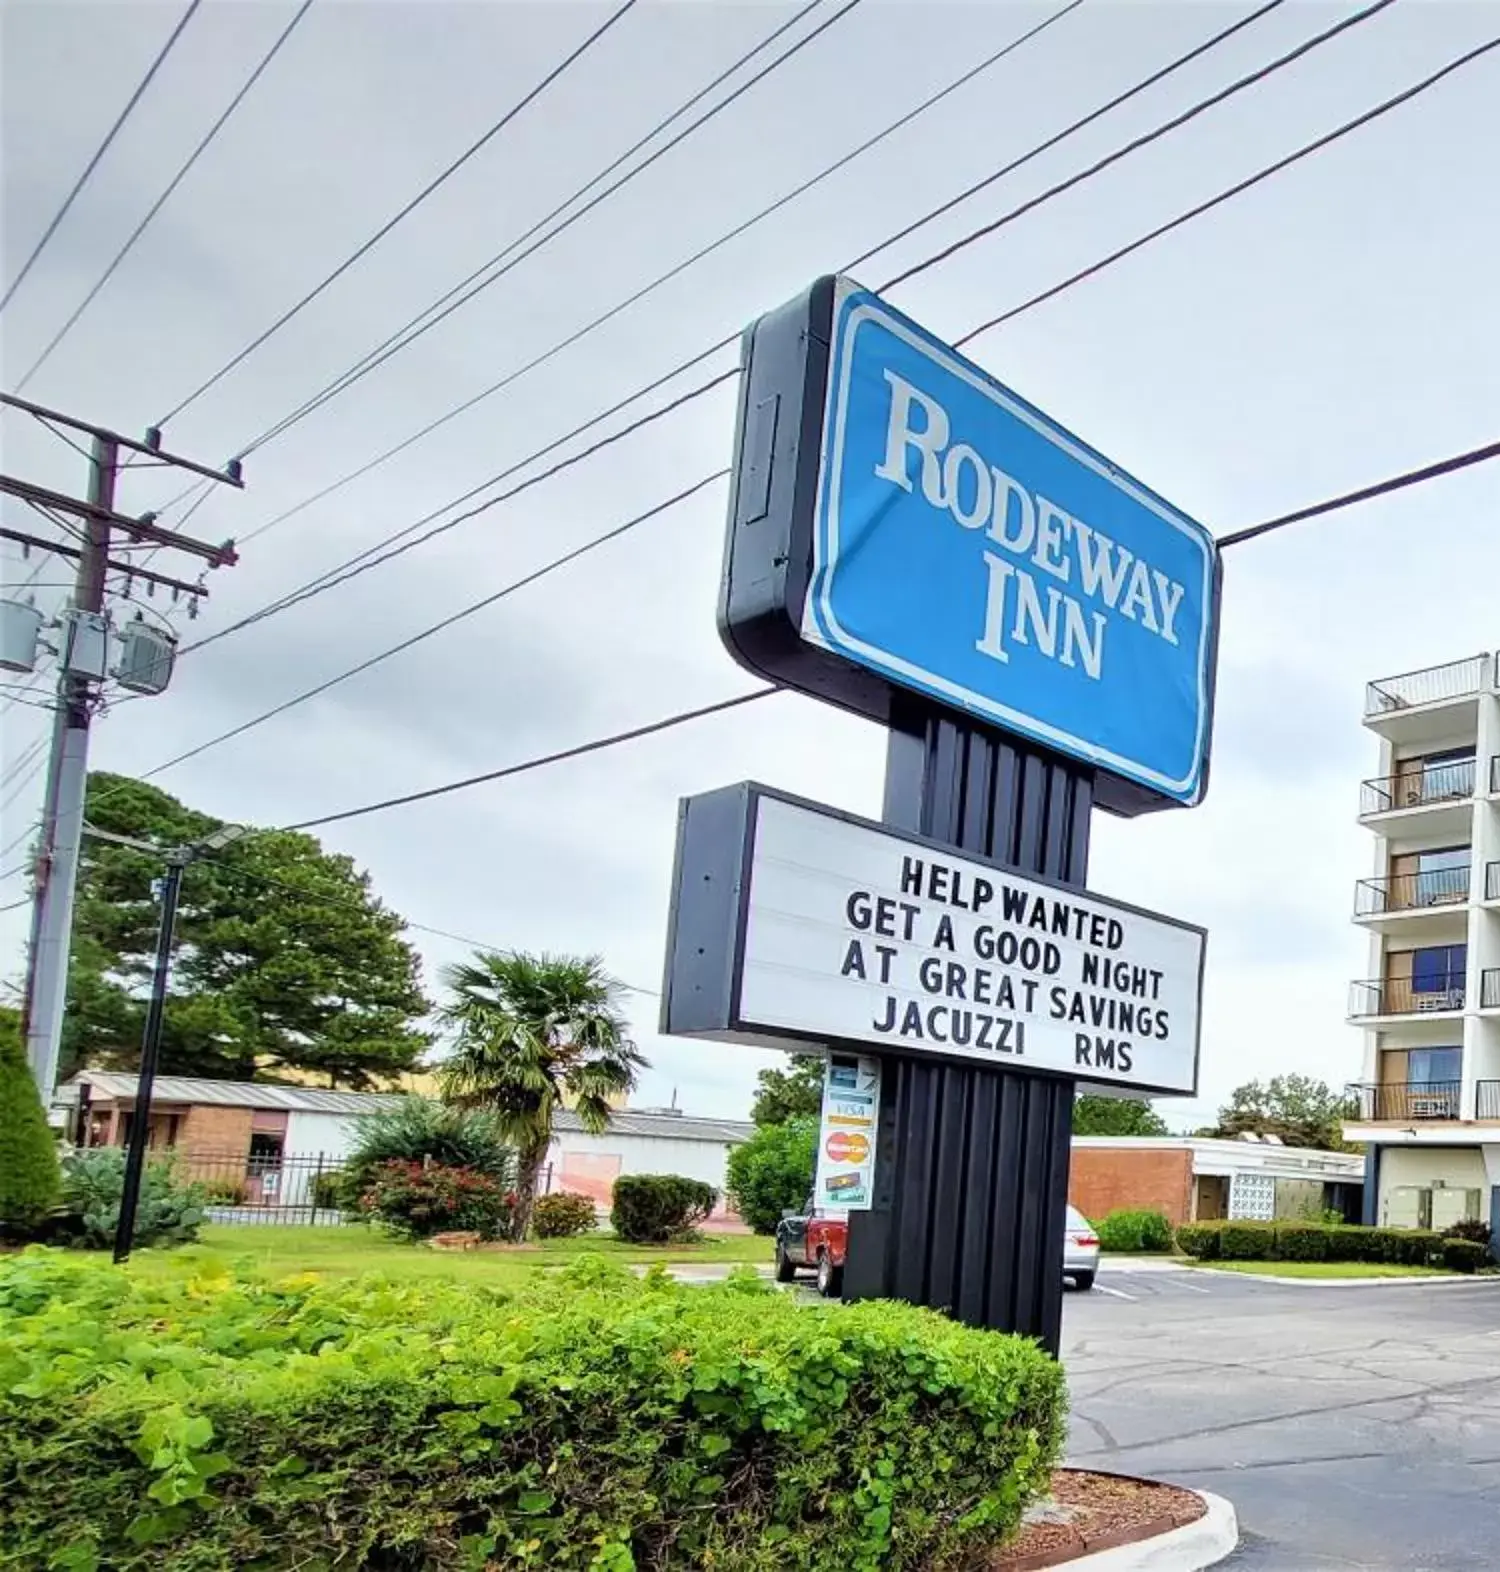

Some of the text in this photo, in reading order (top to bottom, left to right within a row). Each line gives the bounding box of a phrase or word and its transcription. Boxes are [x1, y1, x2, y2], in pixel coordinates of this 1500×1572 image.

[875, 368, 1185, 646] RODEWAY
[975, 551, 1107, 680] INN
[846, 891, 1164, 1000] GET A GOOD NIGHT
[902, 856, 1123, 951] HELP WANTED
[841, 940, 1169, 1040] AT GREAT SAVINGS
[873, 996, 1133, 1073] JACUZZI RMS
